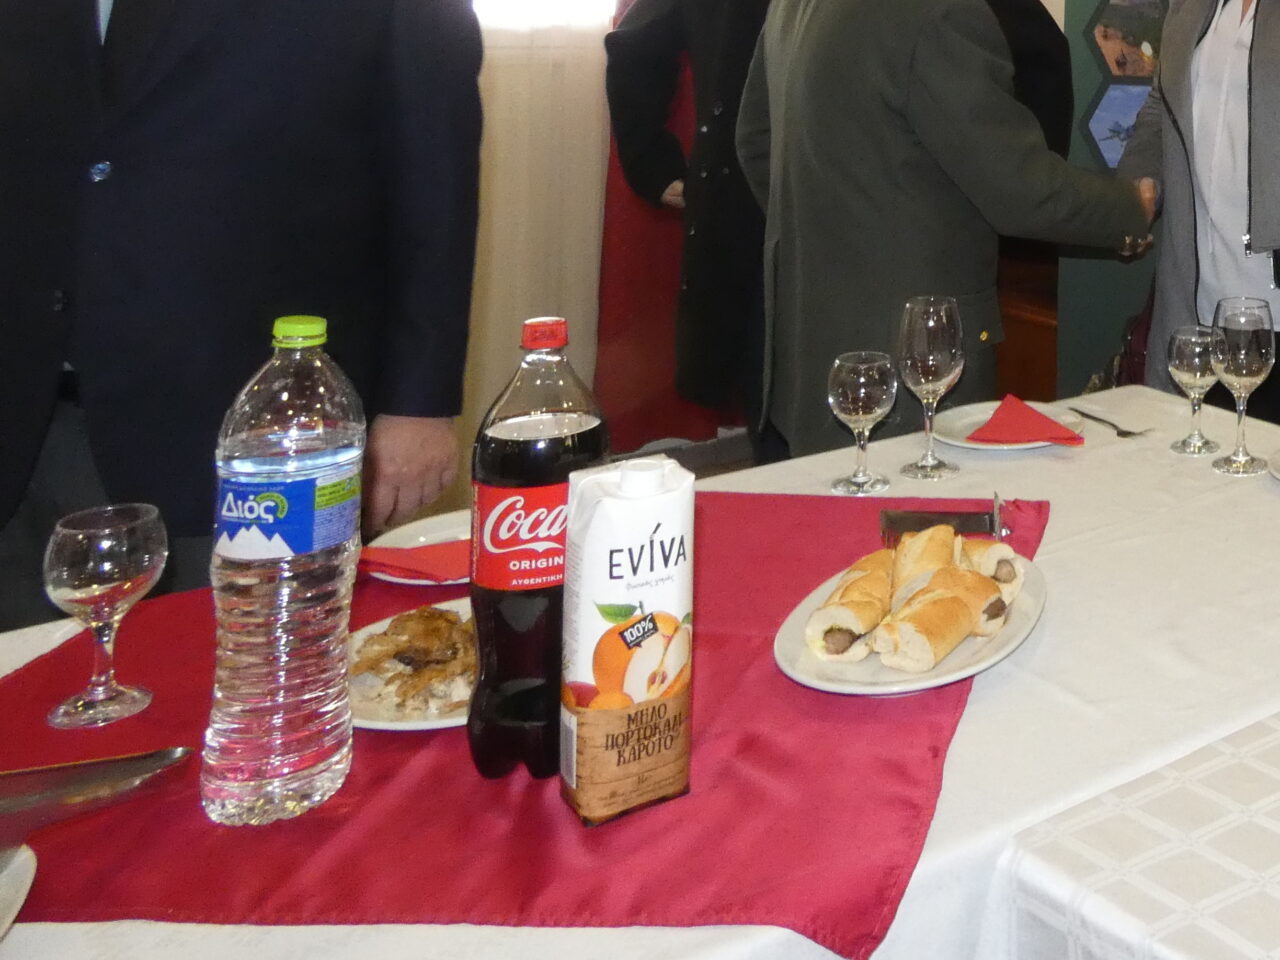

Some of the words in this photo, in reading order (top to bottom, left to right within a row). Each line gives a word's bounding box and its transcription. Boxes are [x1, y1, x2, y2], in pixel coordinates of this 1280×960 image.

[221, 492, 276, 524] Διός
[509, 555, 564, 570] ORIGIN
[624, 615, 654, 642] 100%
[627, 703, 667, 730] ΜΗΛΟ
[616, 735, 674, 767] ΚΑΡΟΤΟ
